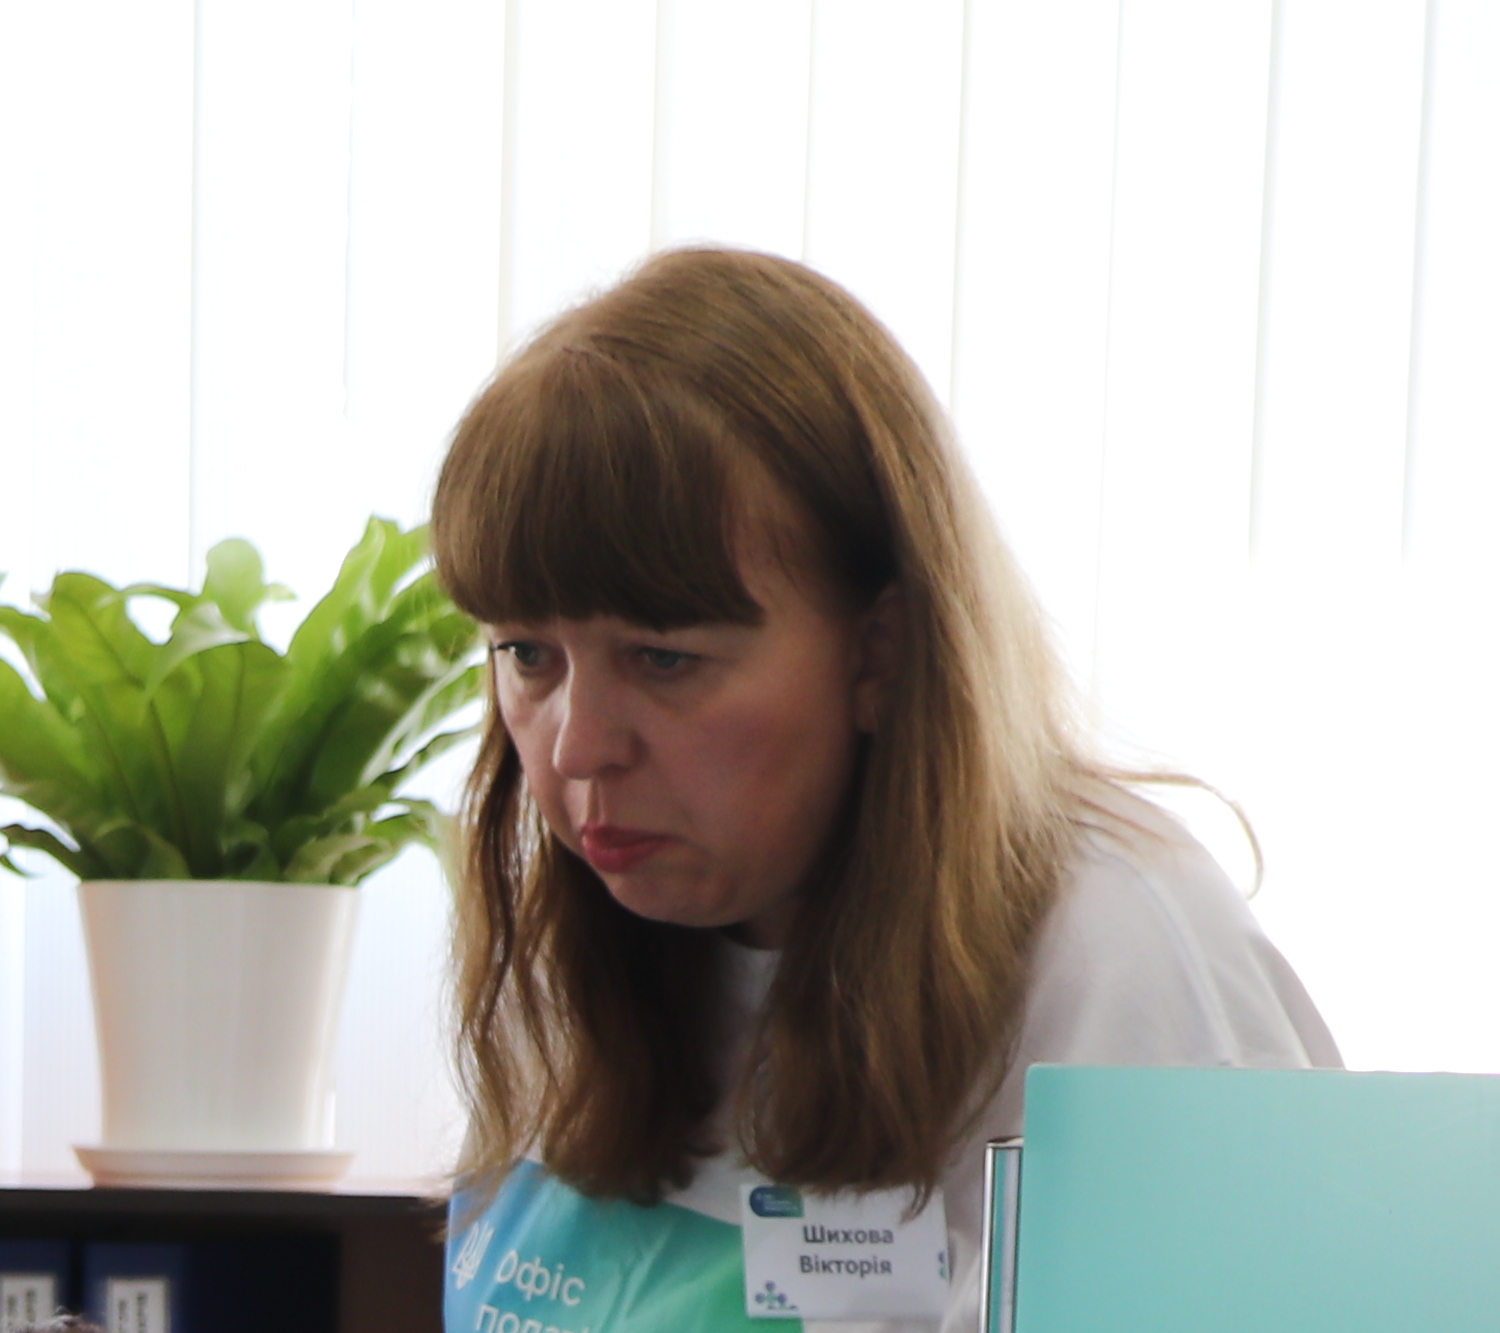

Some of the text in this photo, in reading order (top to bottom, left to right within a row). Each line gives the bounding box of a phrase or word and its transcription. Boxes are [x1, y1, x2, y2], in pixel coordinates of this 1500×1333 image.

[803, 1223, 894, 1247] Шихова
[496, 1251, 586, 1307] Офіс
[799, 1253, 893, 1279] Вікторія
